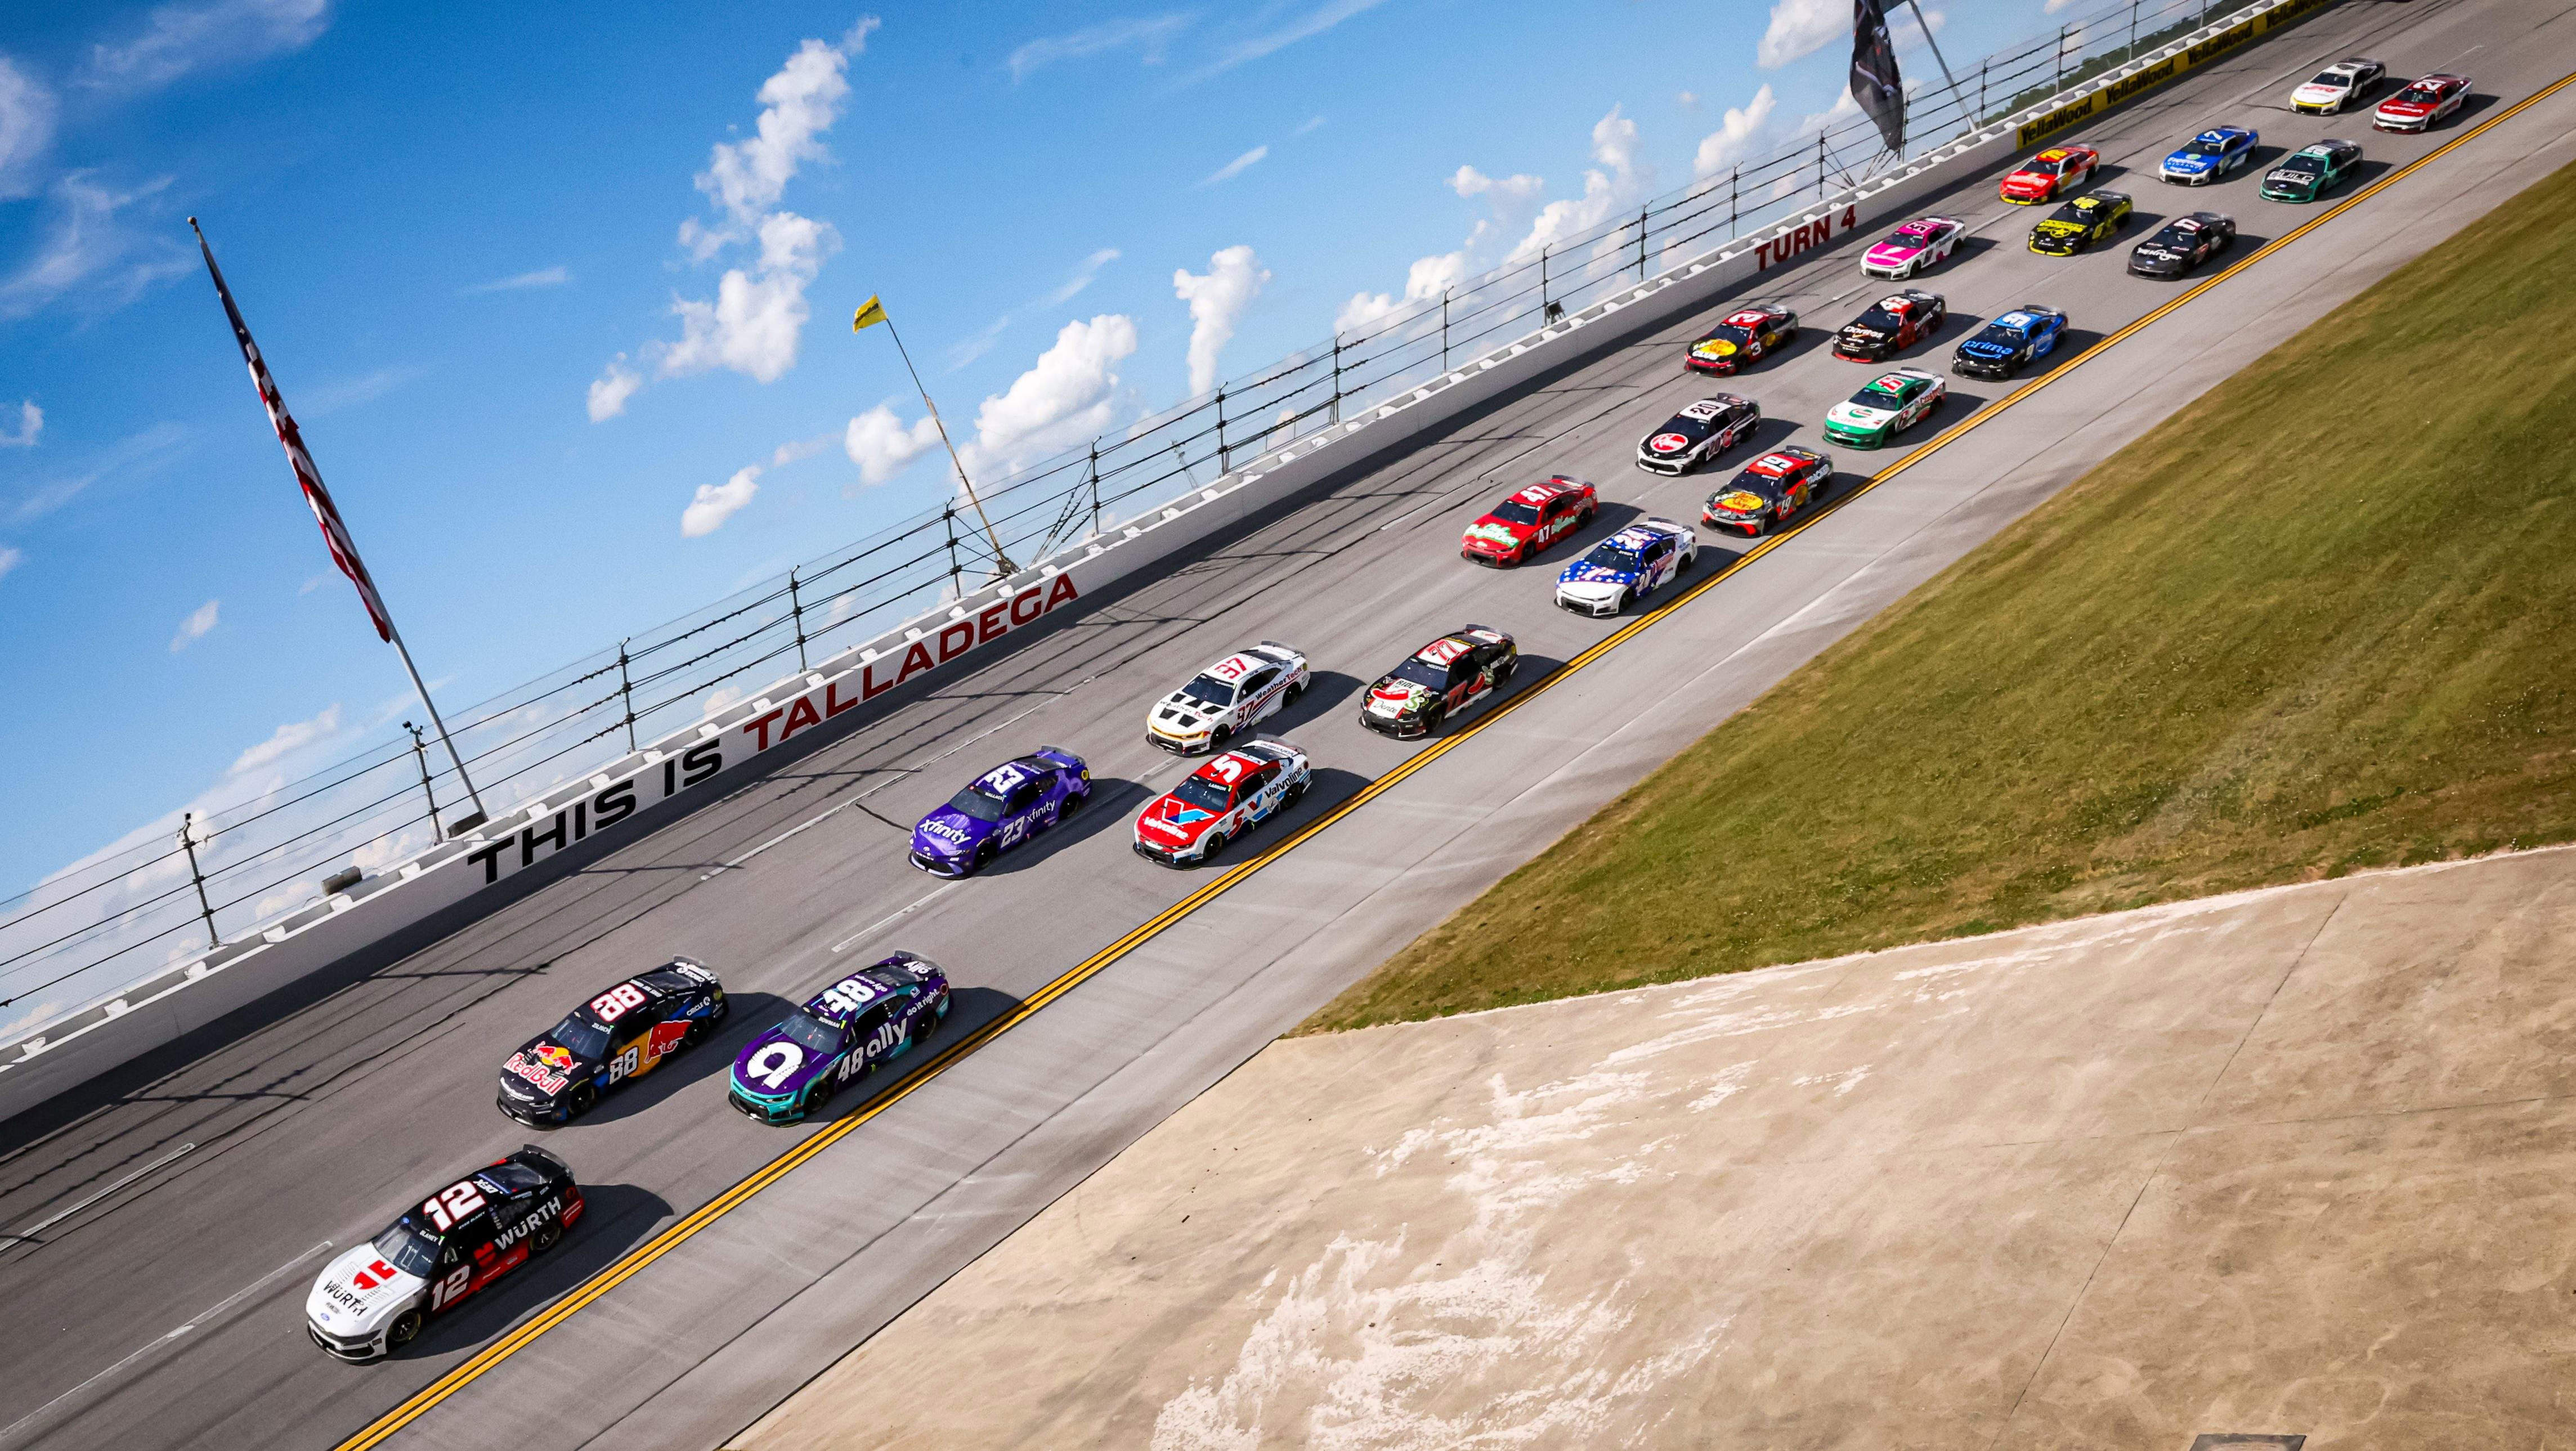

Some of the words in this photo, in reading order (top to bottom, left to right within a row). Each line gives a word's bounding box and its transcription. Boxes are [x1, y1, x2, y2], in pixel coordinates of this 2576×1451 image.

[2106, 57, 2174, 104] YellaWood
[2021, 95, 2093, 145] YellaWood
[1754, 214, 1830, 271] TURN
[1841, 204, 1856, 230] 4
[1690, 404, 1721, 415] 20
[1757, 455, 1794, 473] 19
[1520, 485, 1553, 503] 47
[1214, 657, 1247, 679] 97
[1255, 666, 1302, 701] WeatherTech
[1396, 680, 1417, 689] RIDE
[1237, 700, 1255, 725] 97
[468, 780, 635, 884] THIS
[664, 738, 722, 796] IS
[743, 573, 1078, 752] TALLADEGA
[984, 765, 1025, 794] 23
[1211, 754, 1243, 783] 5
[1264, 767, 1303, 798] Valvoline
[1026, 800, 1056, 823] xfinity
[1227, 808, 1246, 839] 5
[919, 819, 972, 845] xfinity
[1001, 816, 1025, 848] 23
[1143, 816, 1189, 840] Valvoline
[590, 982, 647, 1023] 88
[686, 1002, 704, 1016] CIRCLE
[823, 979, 876, 1013] 48
[818, 1016, 840, 1028] BOWMAN
[866, 1017, 907, 1058] ally
[610, 1046, 639, 1085] 88
[838, 1046, 864, 1082] 48
[422, 1180, 486, 1232] 12
[419, 1229, 438, 1243] BLANEY
[494, 1195, 561, 1250] WÜRTH
[323, 1280, 369, 1317] WÜRTH
[431, 1265, 471, 1312] 12
